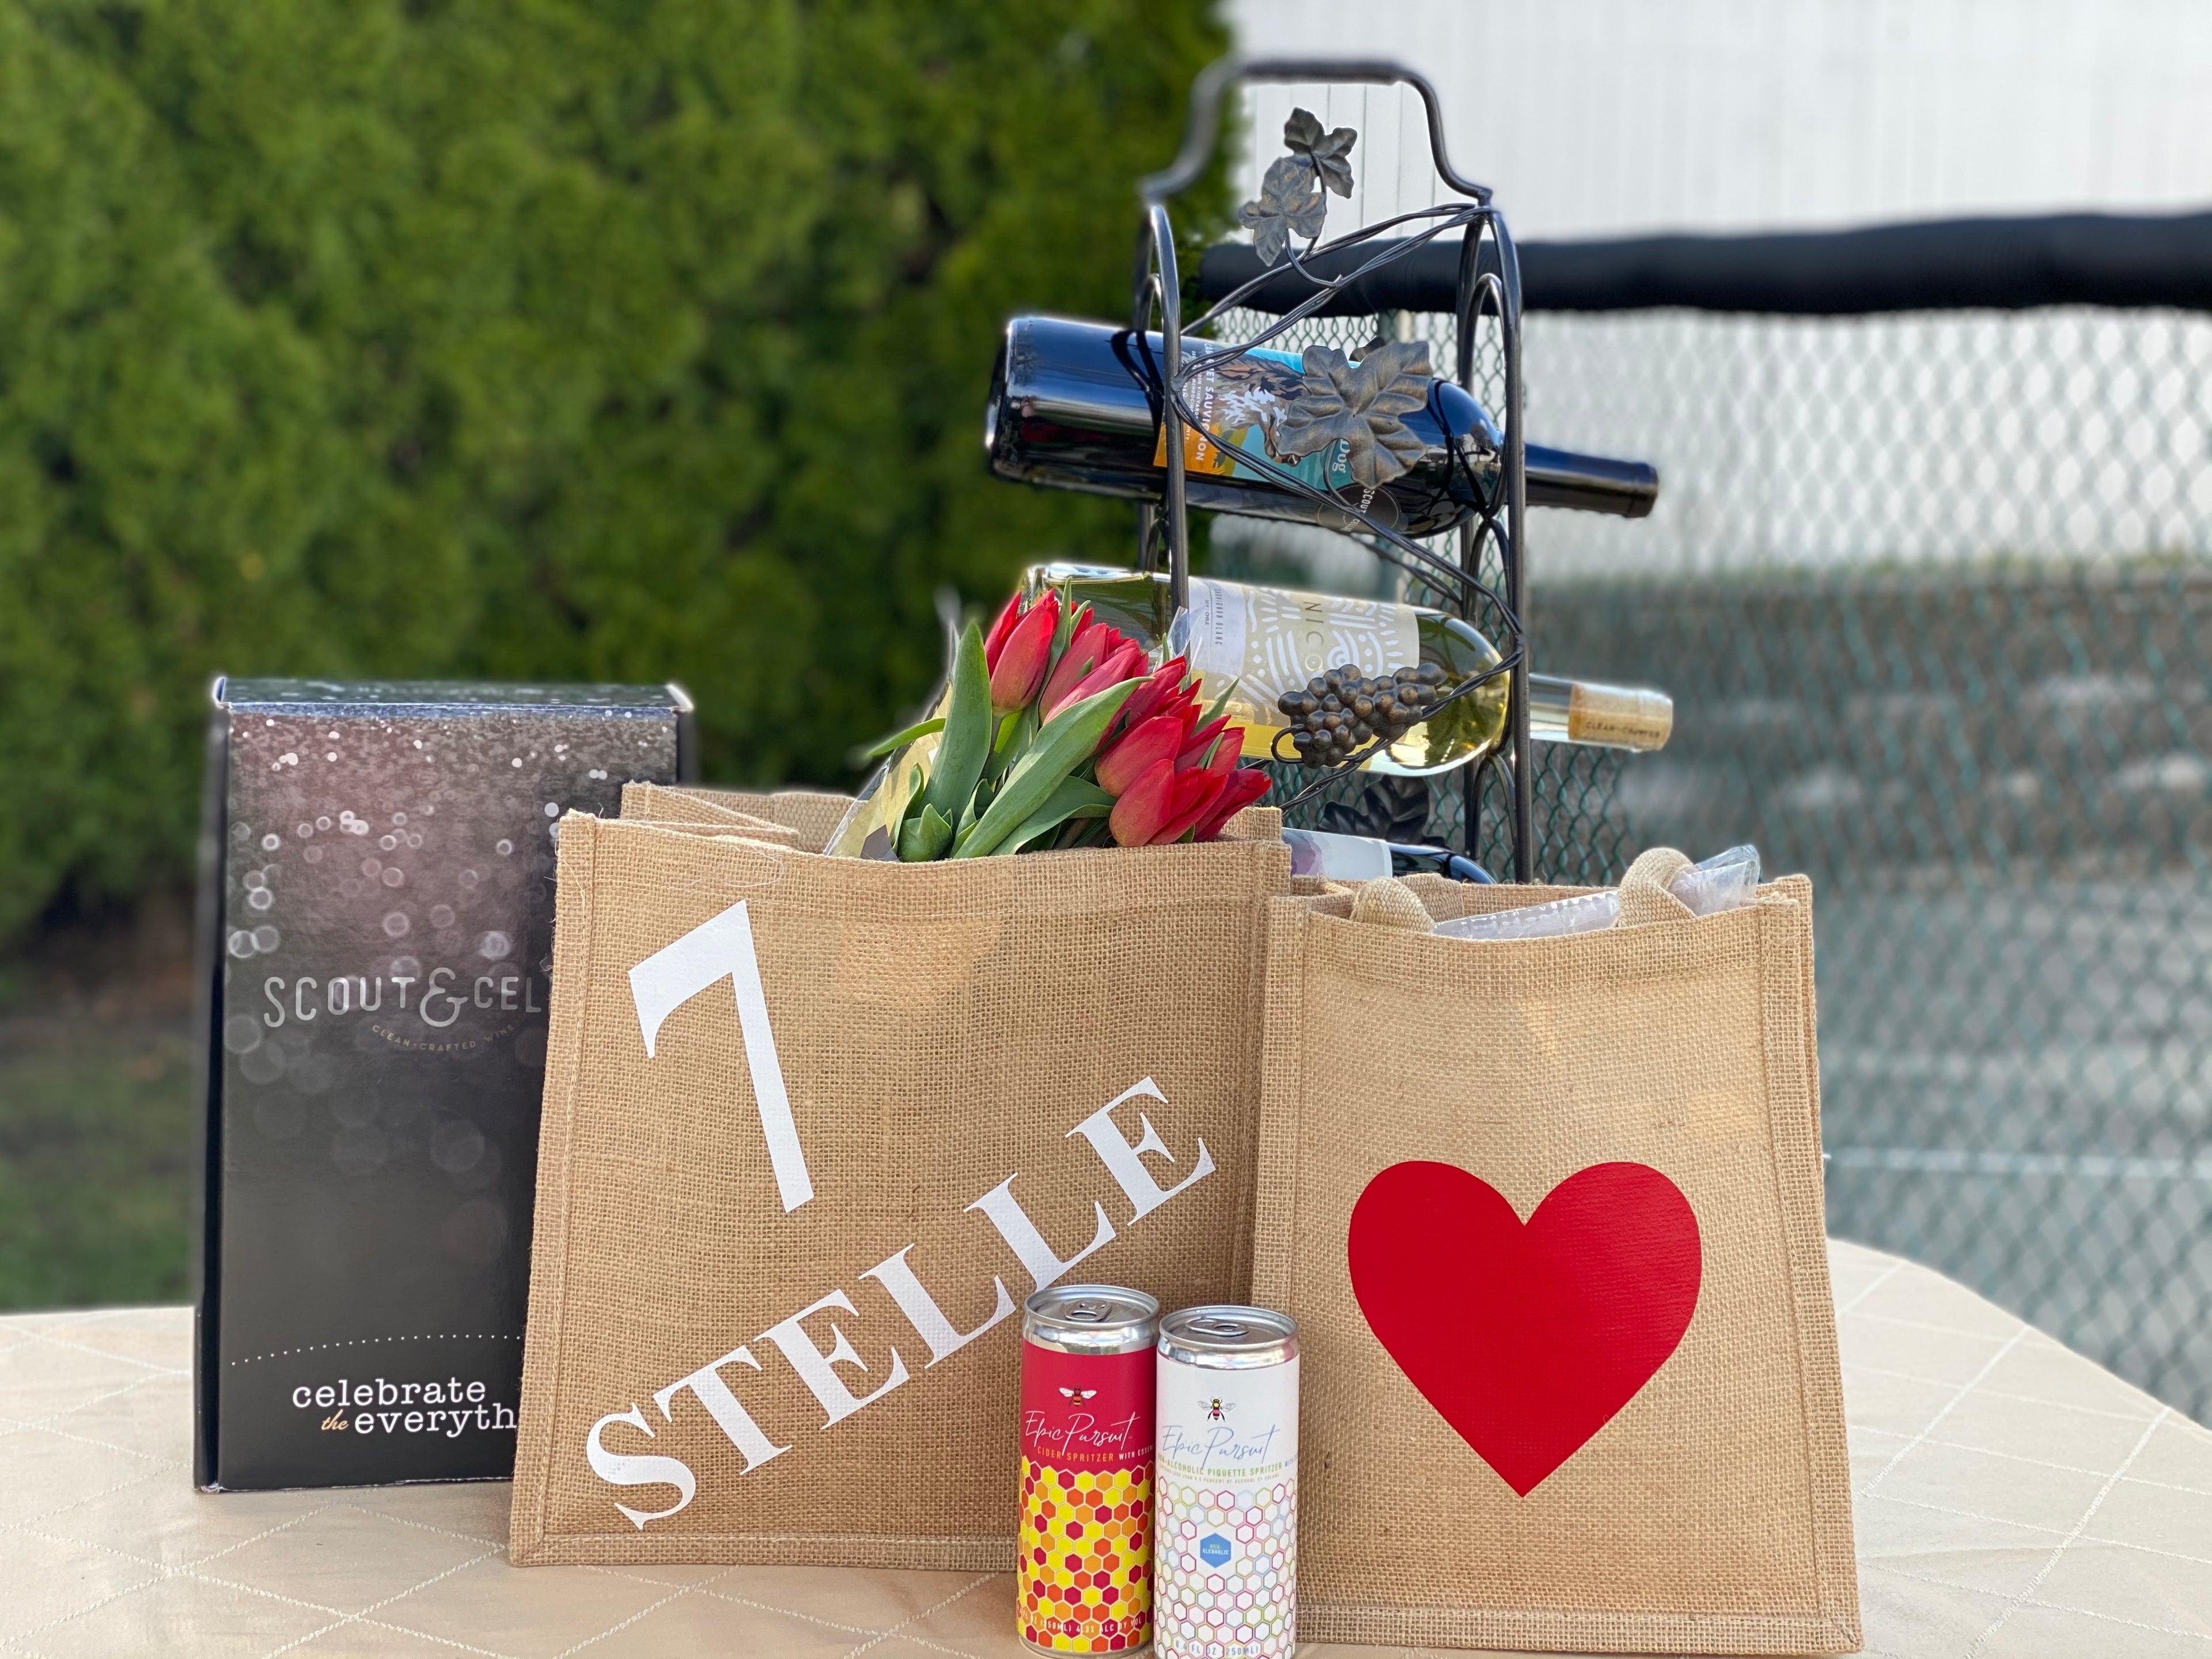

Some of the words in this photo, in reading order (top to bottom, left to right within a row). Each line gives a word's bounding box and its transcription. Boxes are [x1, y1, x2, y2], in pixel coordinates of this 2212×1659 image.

[1332, 439, 1351, 473] Dog
[1360, 488, 1374, 514] SCOUT
[1215, 623, 1224, 645] BLANC
[1304, 601, 1324, 672] NICO
[484, 1024, 516, 1043] WINE
[628, 899, 814, 1214] 7
[585, 1075, 1217, 1530] STELLE
[292, 1377, 486, 1408] celebrate
[321, 1409, 349, 1431] the
[354, 1403, 517, 1438] everyth
[1025, 1410, 1065, 1448] Epic
[1062, 1411, 1141, 1456] Pursuit
[1037, 1445, 1062, 1460] CIDER
[1067, 1453, 1114, 1462] SPRITZER
[1119, 1450, 1135, 1461] WITH
[1161, 1425, 1203, 1460] Epic
[1202, 1424, 1281, 1468] Pursuit
[1207, 1468, 1247, 1477] PIQUETTE
[1250, 1462, 1282, 1476] SPRITZER
